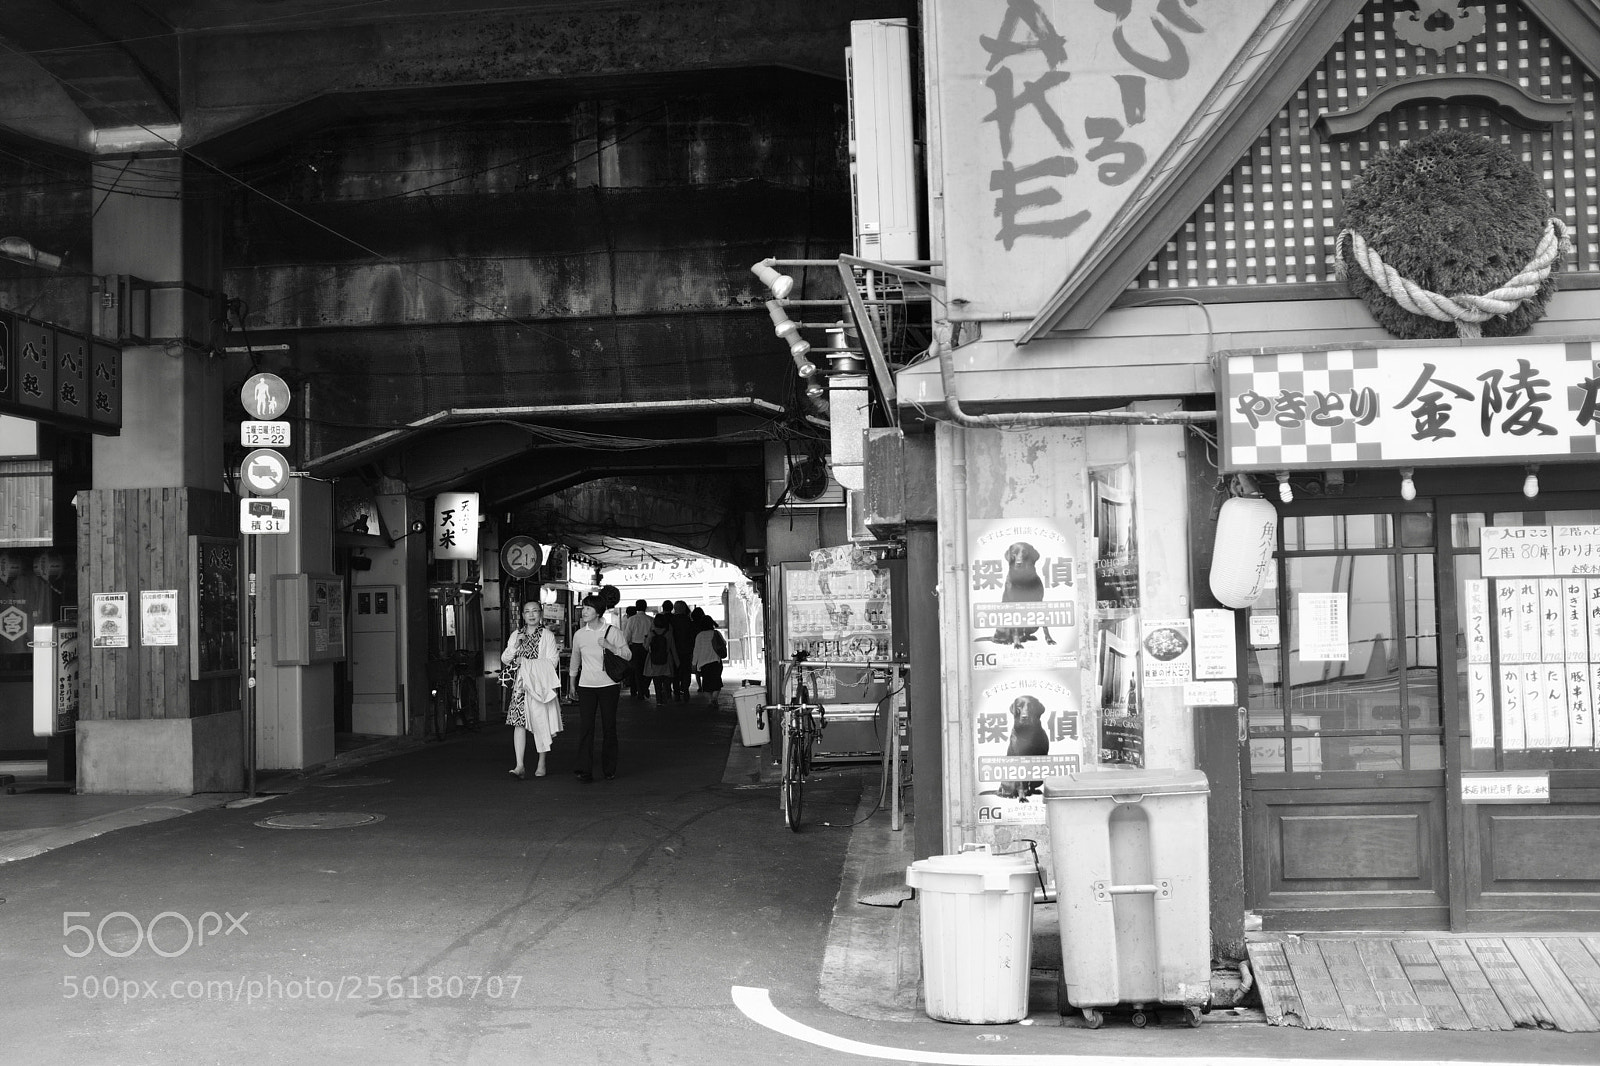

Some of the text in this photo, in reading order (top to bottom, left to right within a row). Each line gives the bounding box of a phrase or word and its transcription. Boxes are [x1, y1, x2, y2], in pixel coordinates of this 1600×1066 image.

[1235, 385, 1378, 430] やきとり
[1392, 358, 1559, 443] 金陵
[439, 509, 457, 550] 天米
[978, 526, 1066, 545] まずはご相談ください
[1248, 520, 1275, 595] 角ハイボール
[1521, 584, 1536, 615] れば
[1544, 587, 1559, 621] かわ
[974, 653, 997, 666] AG
[984, 679, 1071, 697] まずはご相談ください
[1504, 670, 1518, 711] かしら
[1525, 670, 1539, 701] はつ
[1547, 670, 1561, 700] たん
[978, 807, 1002, 820] AG
